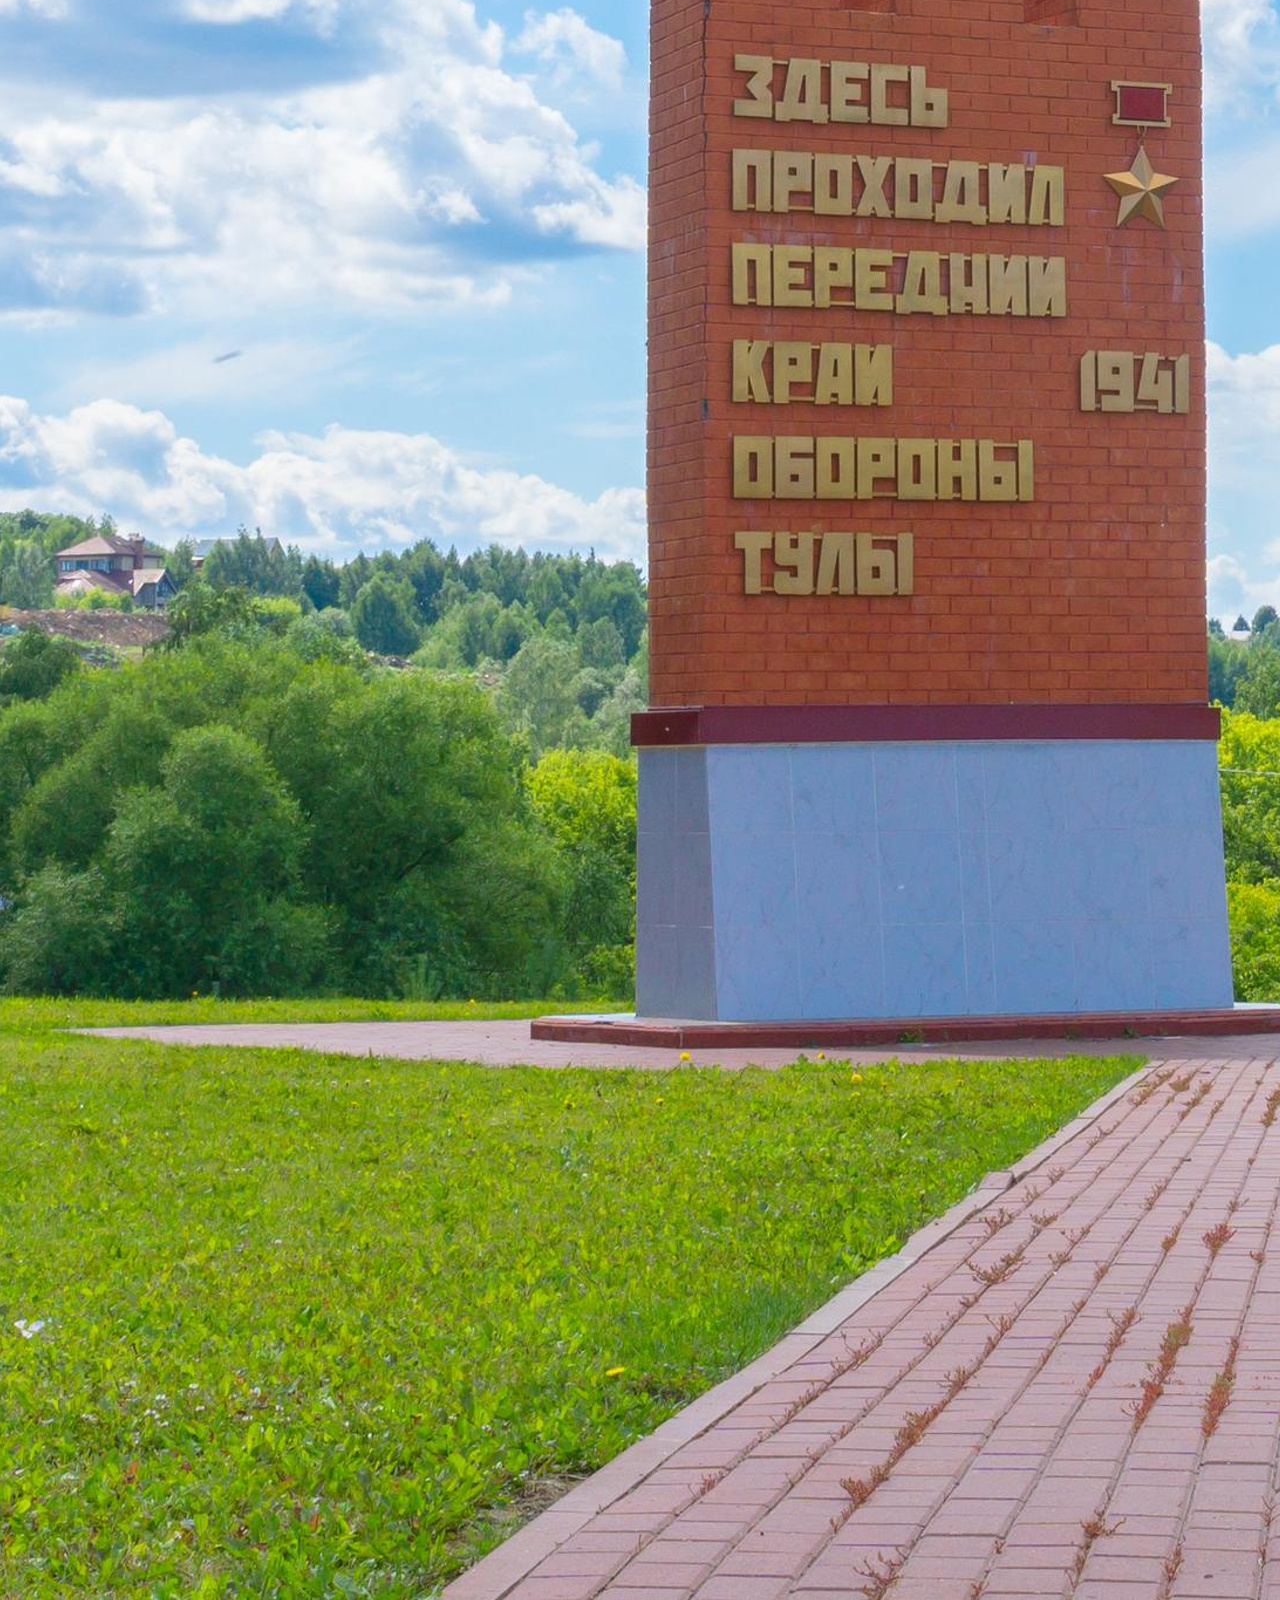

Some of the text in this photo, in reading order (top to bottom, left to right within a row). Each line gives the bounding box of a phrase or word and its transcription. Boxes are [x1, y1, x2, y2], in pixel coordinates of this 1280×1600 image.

[733, 54, 948, 128] ЗДЕСЬ
[732, 149, 1065, 226] ПРОХОДИЛ
[1080, 350, 1190, 413] 1941
[733, 435, 1034, 501] ОБОРОНЫ
[734, 531, 914, 595] ТУЛЫ
